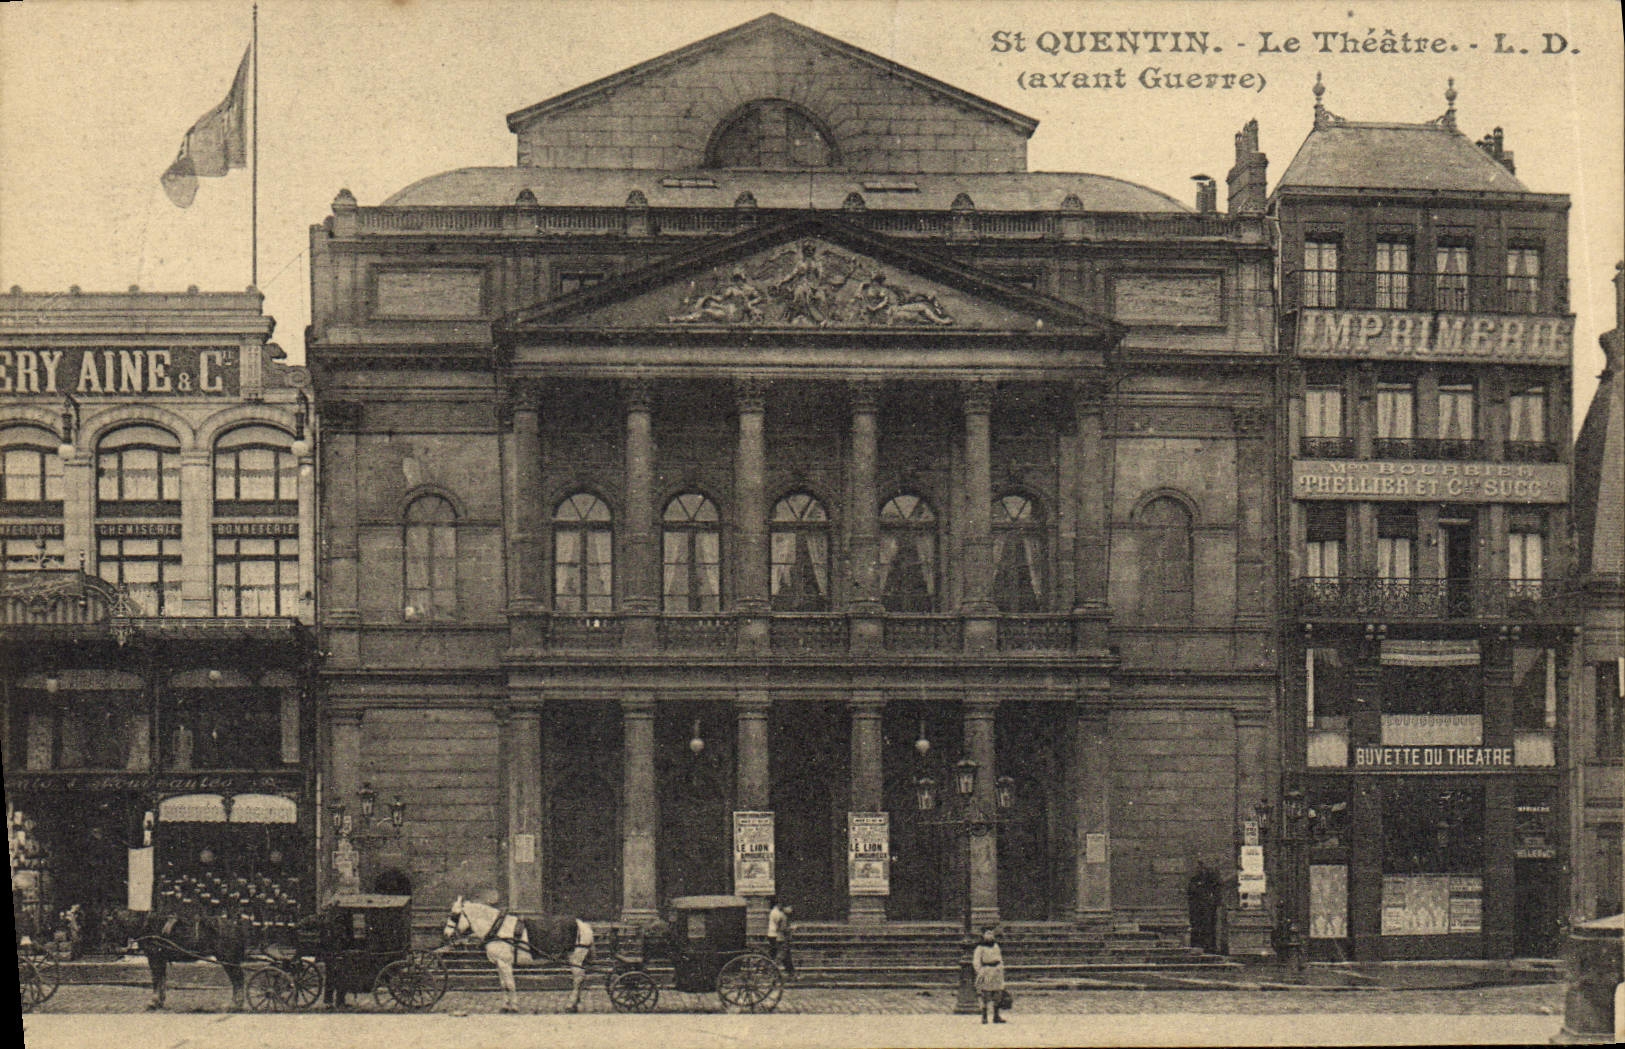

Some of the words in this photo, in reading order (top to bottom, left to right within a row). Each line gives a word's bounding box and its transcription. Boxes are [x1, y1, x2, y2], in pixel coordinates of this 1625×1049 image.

[1302, 310, 1571, 358] IMPRIMERIE
[76, 350, 173, 393] AINE
[177, 372, 193, 392] &
[1299, 475, 1410, 495] THELLIER
[1415, 479, 1440, 496] ET
[100, 524, 178, 536] CHEMISERIE
[217, 524, 296, 535] BONNETERIE
[1356, 748, 1420, 766] BUVETTE
[1424, 748, 1443, 766] DU
[736, 843, 746, 853] LE
[749, 843, 769, 852] LION
[850, 843, 860, 852] LE
[863, 843, 882, 852] LION
